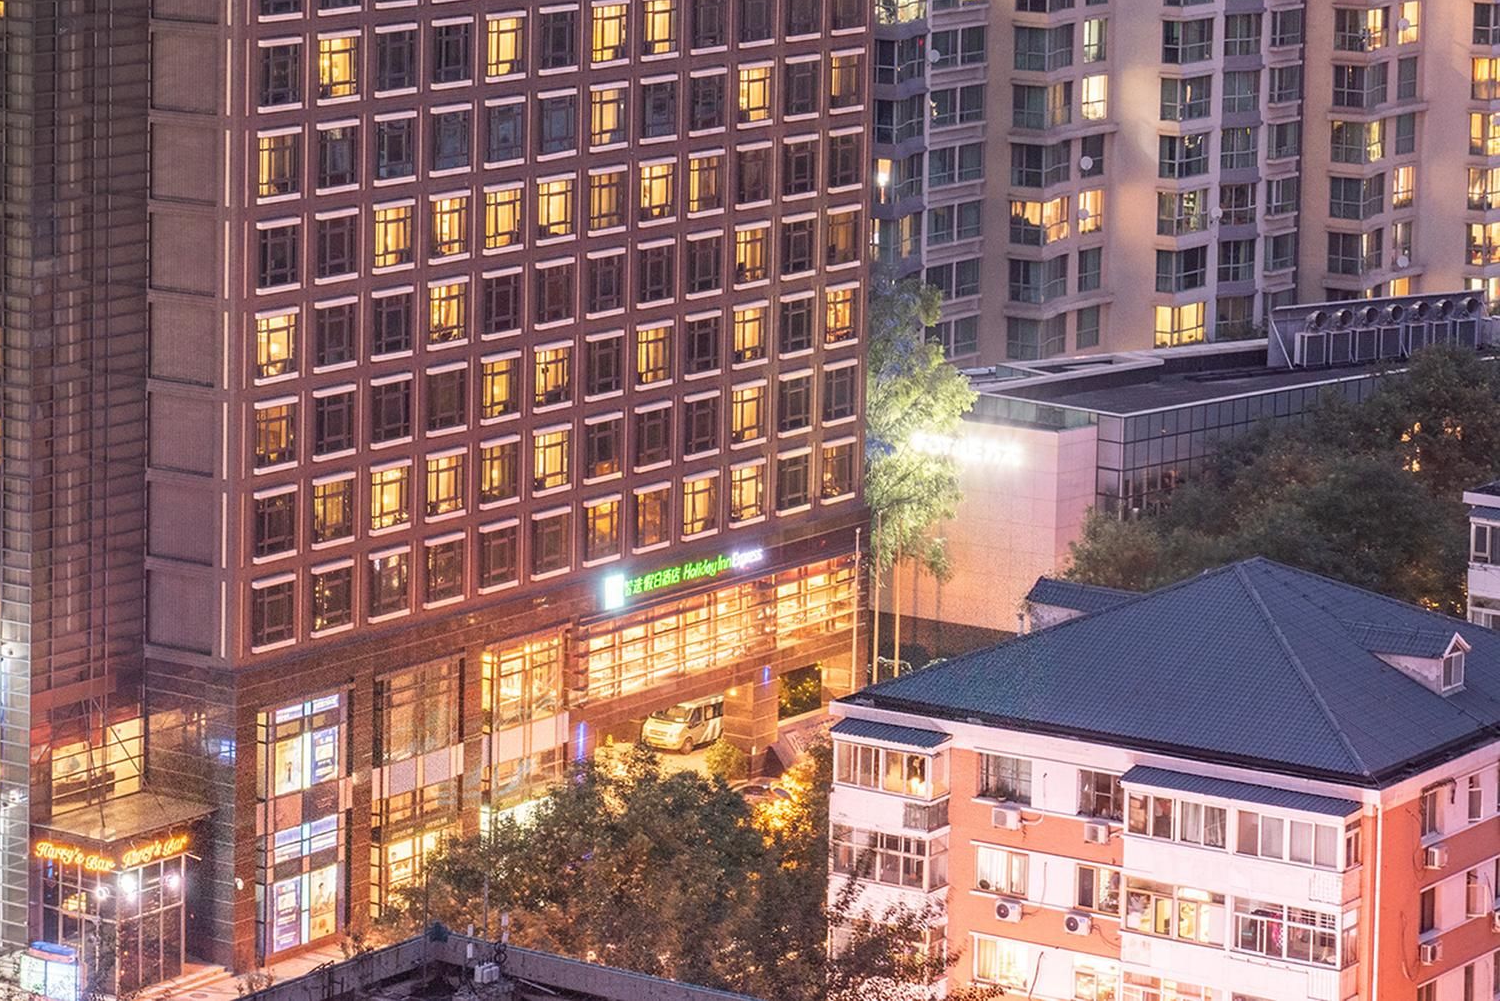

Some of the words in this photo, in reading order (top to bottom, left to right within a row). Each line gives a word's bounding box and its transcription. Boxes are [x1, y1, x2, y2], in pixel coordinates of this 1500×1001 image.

[683, 559, 718, 580] Holiday
[717, 554, 732, 571] Inn
[35, 841, 84, 865] Harry's
[84, 855, 116, 872] Bar
[163, 834, 189, 856] Bar
